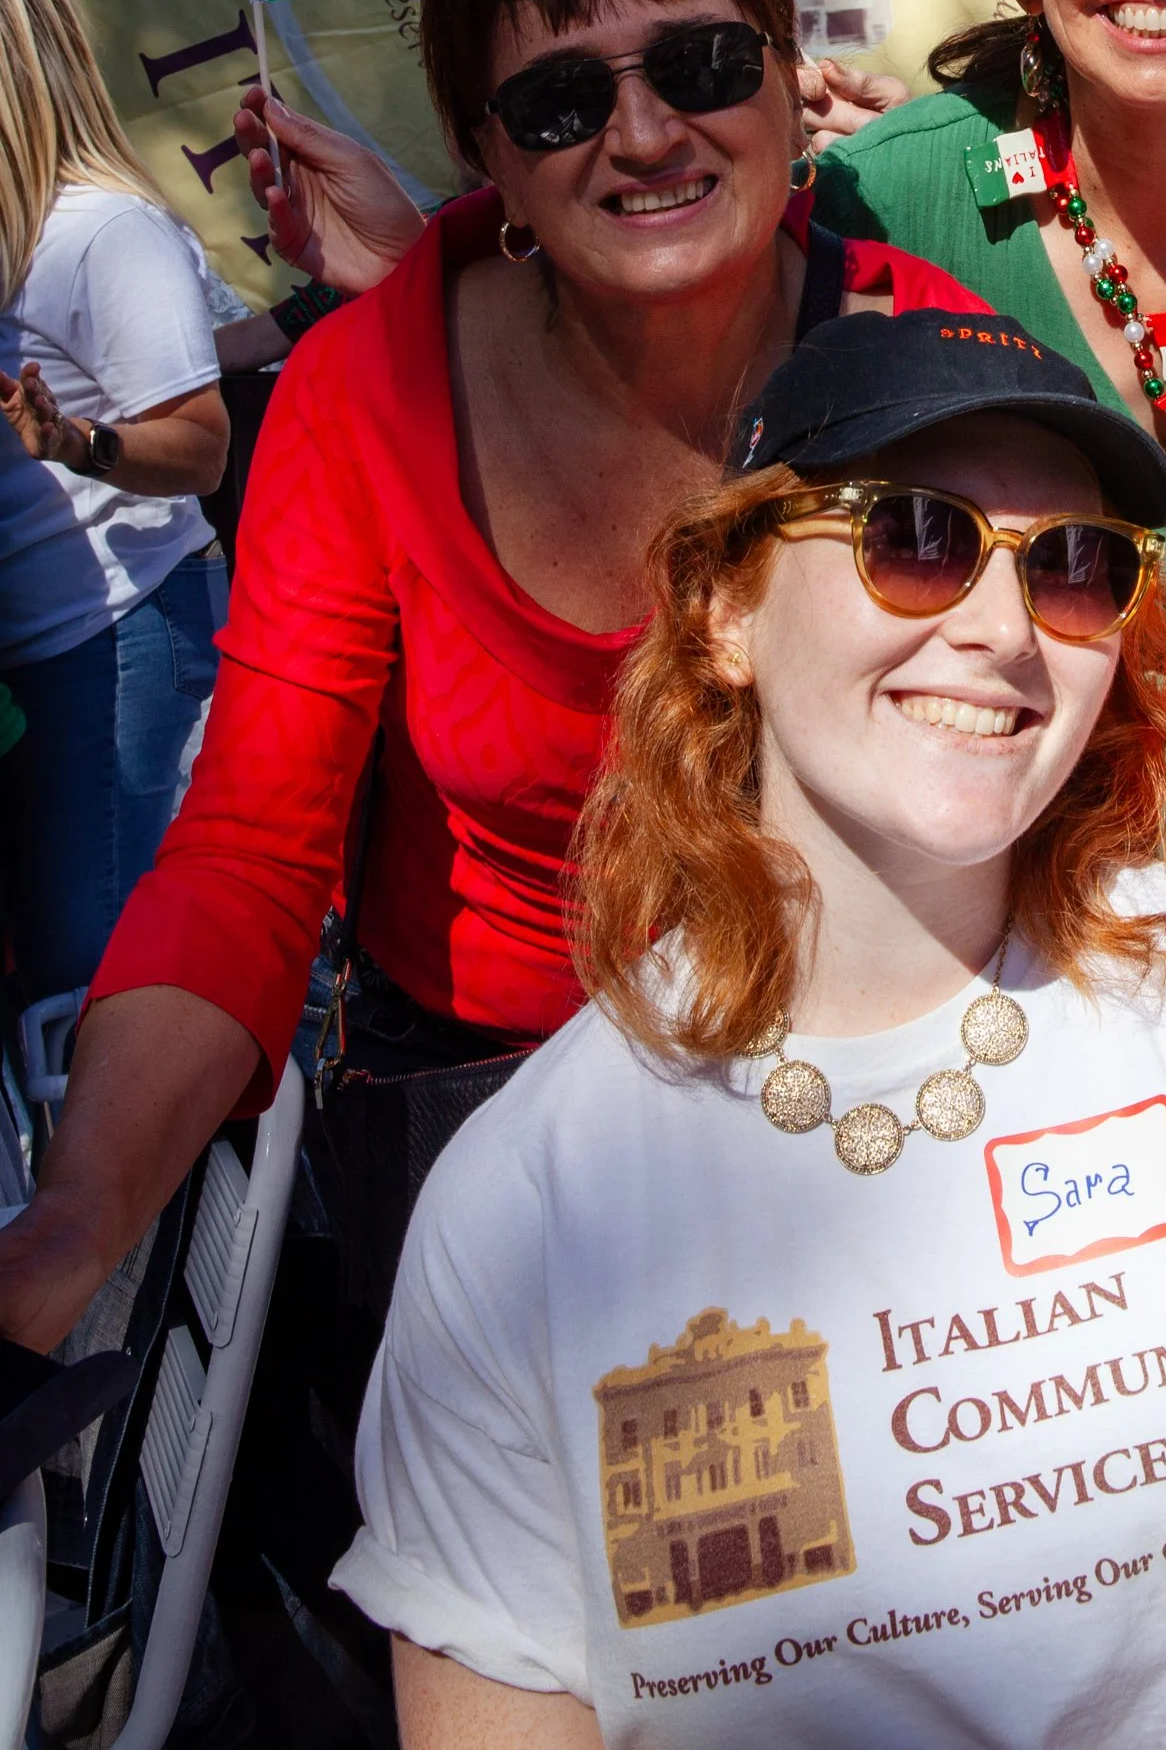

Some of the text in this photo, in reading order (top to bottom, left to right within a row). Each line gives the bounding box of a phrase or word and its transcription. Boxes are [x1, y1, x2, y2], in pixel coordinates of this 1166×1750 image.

[1020, 1160, 1135, 1237] Sara
[872, 1271, 1128, 1374] ITALIAN
[631, 1553, 1154, 1700] Preserving Our Culture, Serving Our
